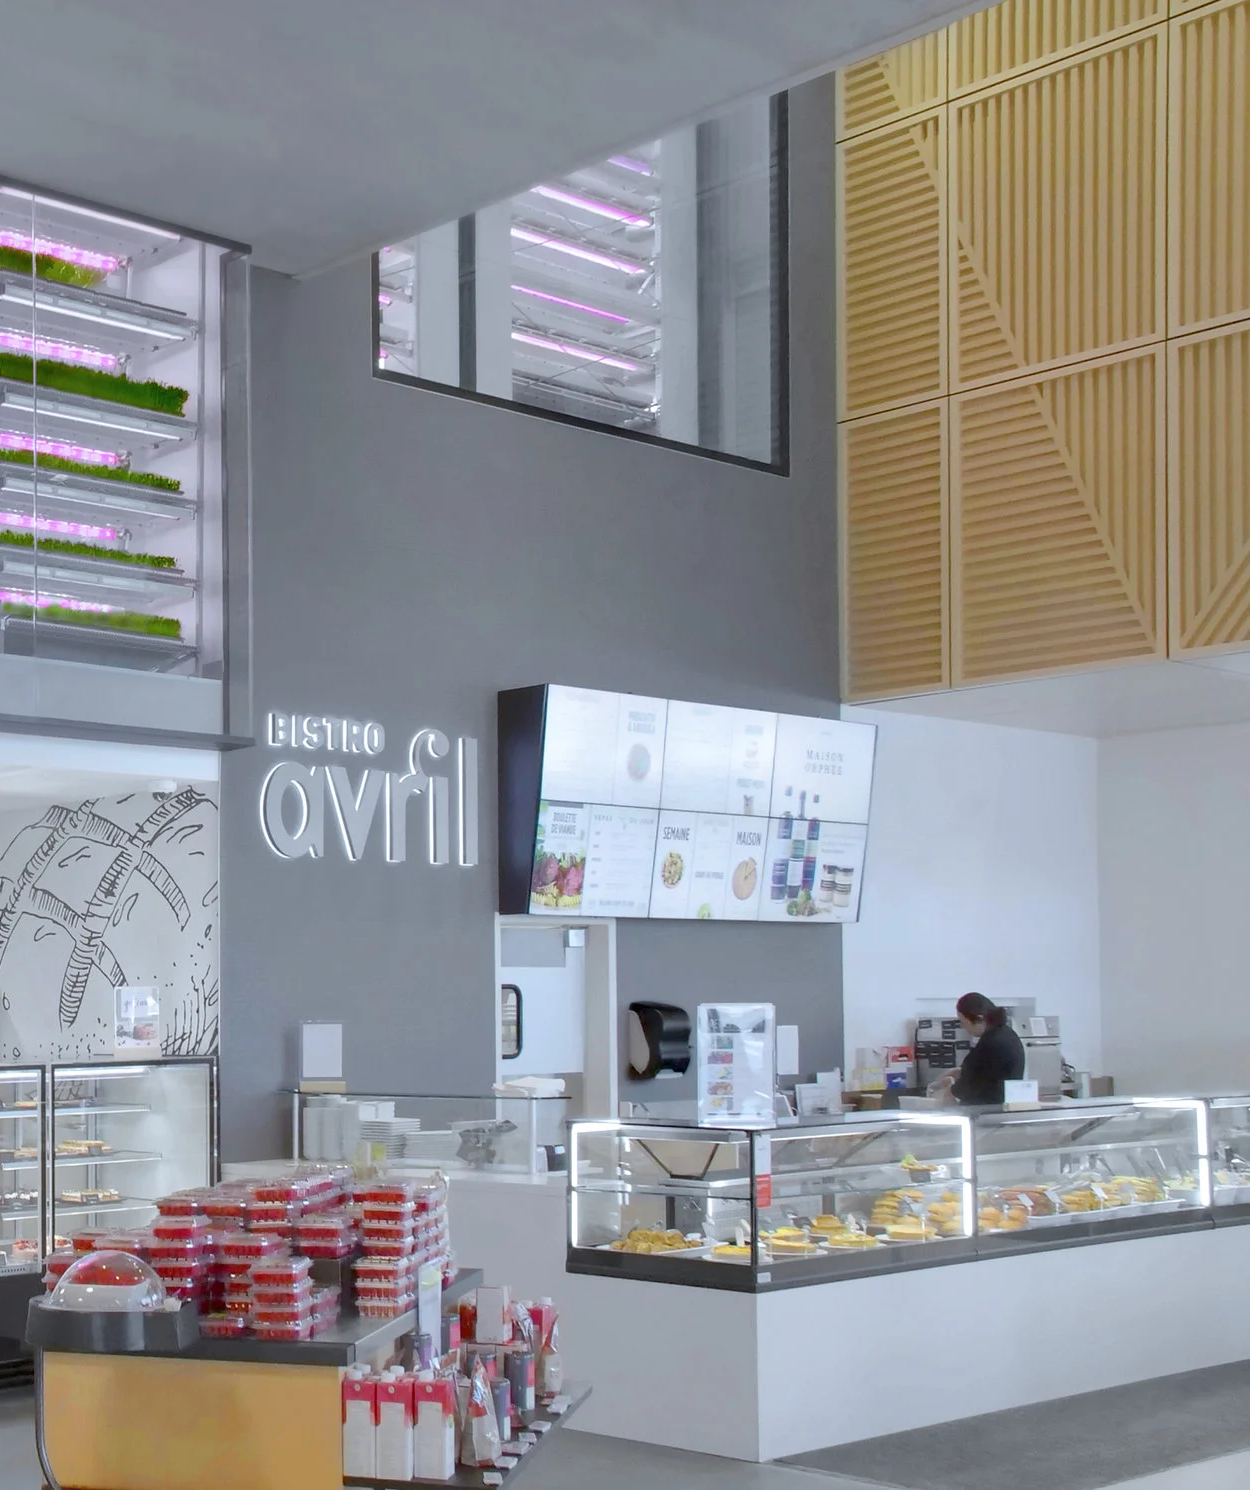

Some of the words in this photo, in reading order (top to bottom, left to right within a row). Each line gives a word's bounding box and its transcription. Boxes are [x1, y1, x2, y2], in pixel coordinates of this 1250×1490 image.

[267, 713, 385, 754] BISTRO
[806, 749, 844, 762] MAISON
[260, 728, 478, 866] avril
[553, 812, 578, 824] BOULETTE
[551, 822, 558, 834] DE
[558, 823, 576, 836] VIANDE
[663, 826, 690, 841] SEMAINE
[736, 831, 762, 846] MAISON
